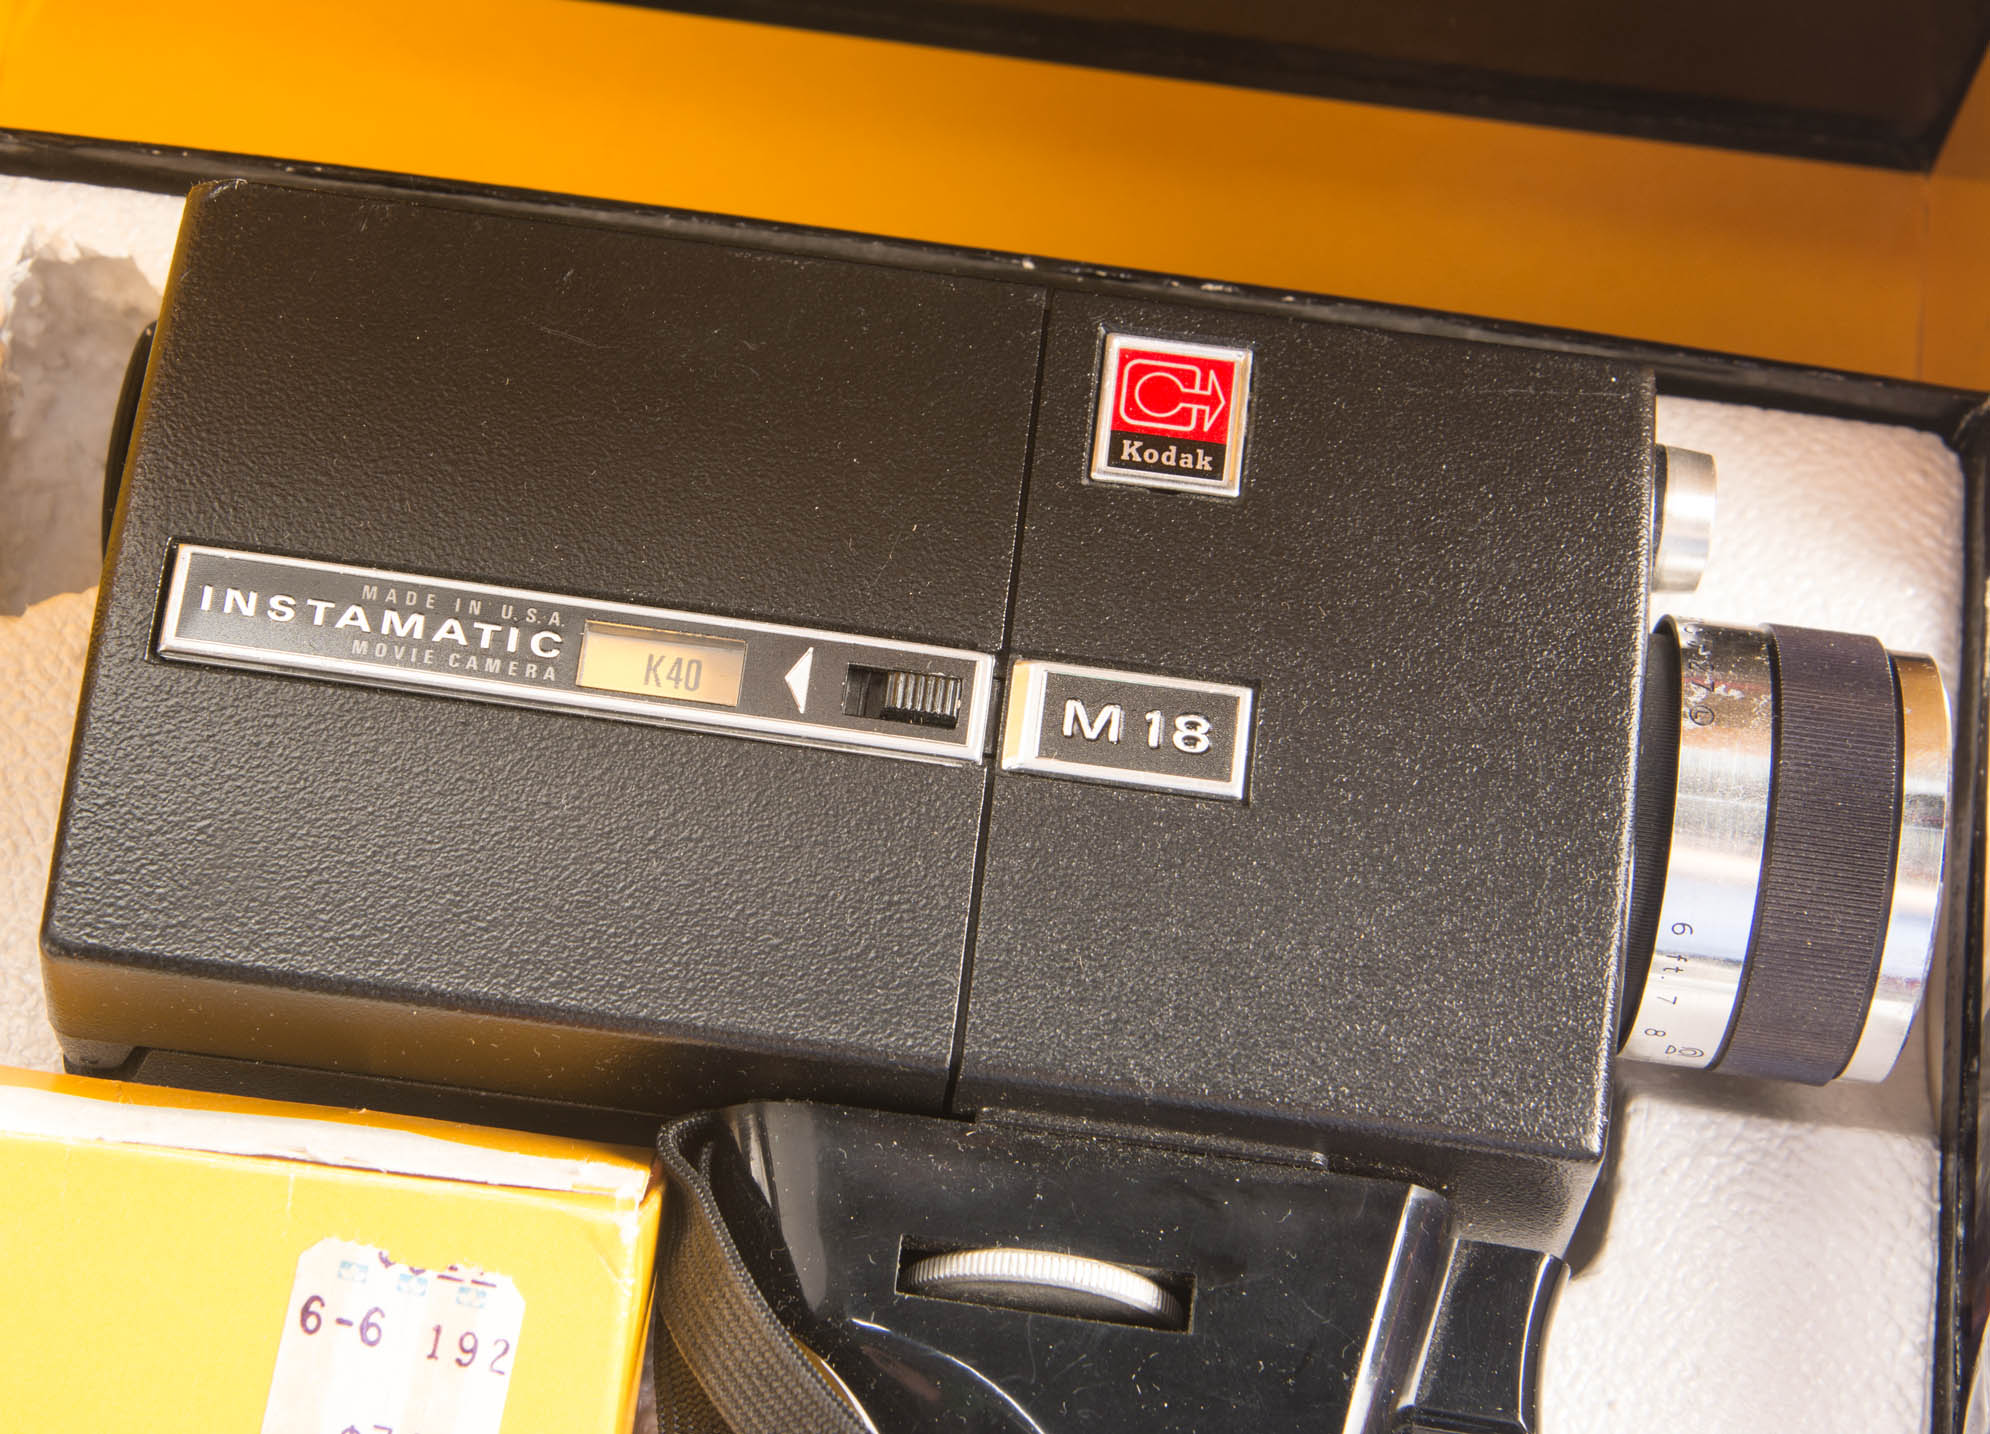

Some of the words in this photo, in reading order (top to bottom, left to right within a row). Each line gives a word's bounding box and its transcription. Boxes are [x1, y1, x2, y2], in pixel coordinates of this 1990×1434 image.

[1120, 440, 1213, 471] Kodak
[199, 584, 564, 659] INSTAMATIC
[361, 584, 436, 610] MADE
[455, 598, 482, 615] IN
[501, 604, 565, 628] U.S.A.
[351, 639, 435, 665] MOVIE
[447, 653, 556, 682] CAMERA
[643, 653, 703, 692] K40
[1062, 698, 1125, 745] M
[1144, 709, 1212, 754] 18
[1671, 922, 1694, 936] 6
[1644, 1027, 1667, 1038] 8
[300, 1294, 386, 1348] 6-6
[426, 1324, 511, 1376] 192
